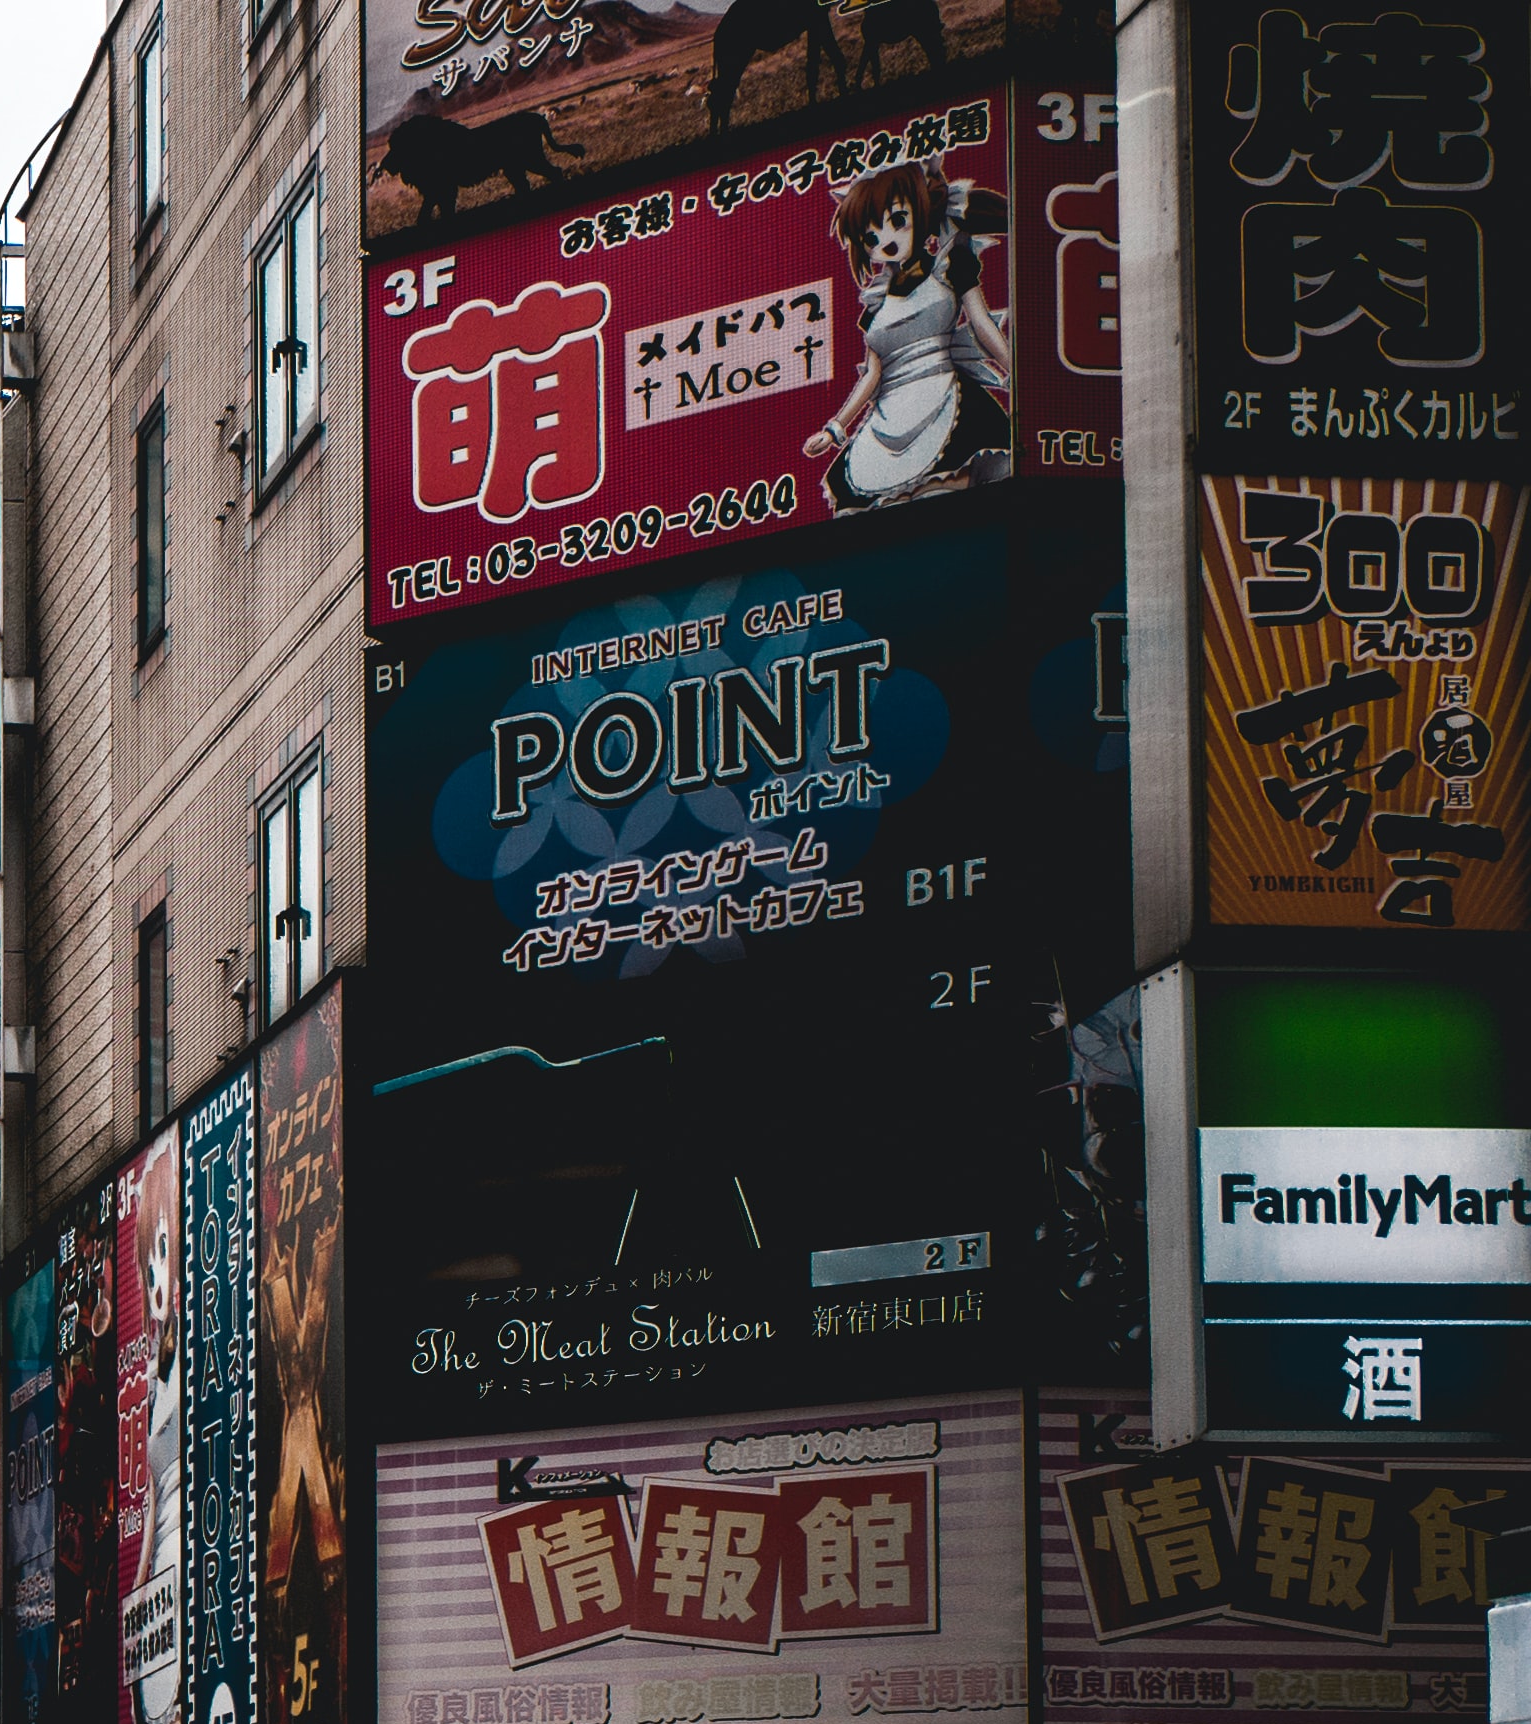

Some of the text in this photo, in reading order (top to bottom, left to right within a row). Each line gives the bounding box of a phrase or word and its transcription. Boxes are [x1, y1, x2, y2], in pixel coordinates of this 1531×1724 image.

[433, 17, 594, 97] サバンナ
[560, 100, 995, 257] お客様・女の子飲み放題
[1224, 8, 1494, 369] 焼肉
[384, 259, 458, 317] 3F
[403, 280, 608, 522] 萌
[676, 356, 781, 409] Moe
[1225, 387, 1523, 440] 2F まんぷくカルビ
[1239, 486, 1496, 627] 300
[533, 590, 843, 685] INTERNET CAFE
[1354, 622, 1475, 662] えんより
[488, 640, 889, 827] POINT
[1419, 674, 1493, 810] 居酒屋
[750, 767, 889, 820] ポイント
[535, 828, 827, 917] オンラインゲーム
[906, 857, 987, 907] B1F
[504, 879, 863, 970] インターネットカフェ
[929, 964, 992, 1009] 2F
[116, 1169, 138, 1221] 3F
[1219, 1173, 1531, 1238] FamilyMart
[465, 1264, 713, 1311] チーズフォンデュ 肉バル
[925, 1236, 984, 1270] 2F
[410, 1303, 777, 1375] The Meat Station
[810, 1288, 985, 1339] 新宿東口店
[199, 1142, 224, 1674] TORA TORA
[477, 1361, 708, 1400] ザ・ミートステーション
[1343, 1335, 1425, 1422] 酒
[705, 1421, 941, 1475] お店選びの決定版
[508, 1493, 913, 1632] 情報館
[290, 1630, 318, 1718] 5F
